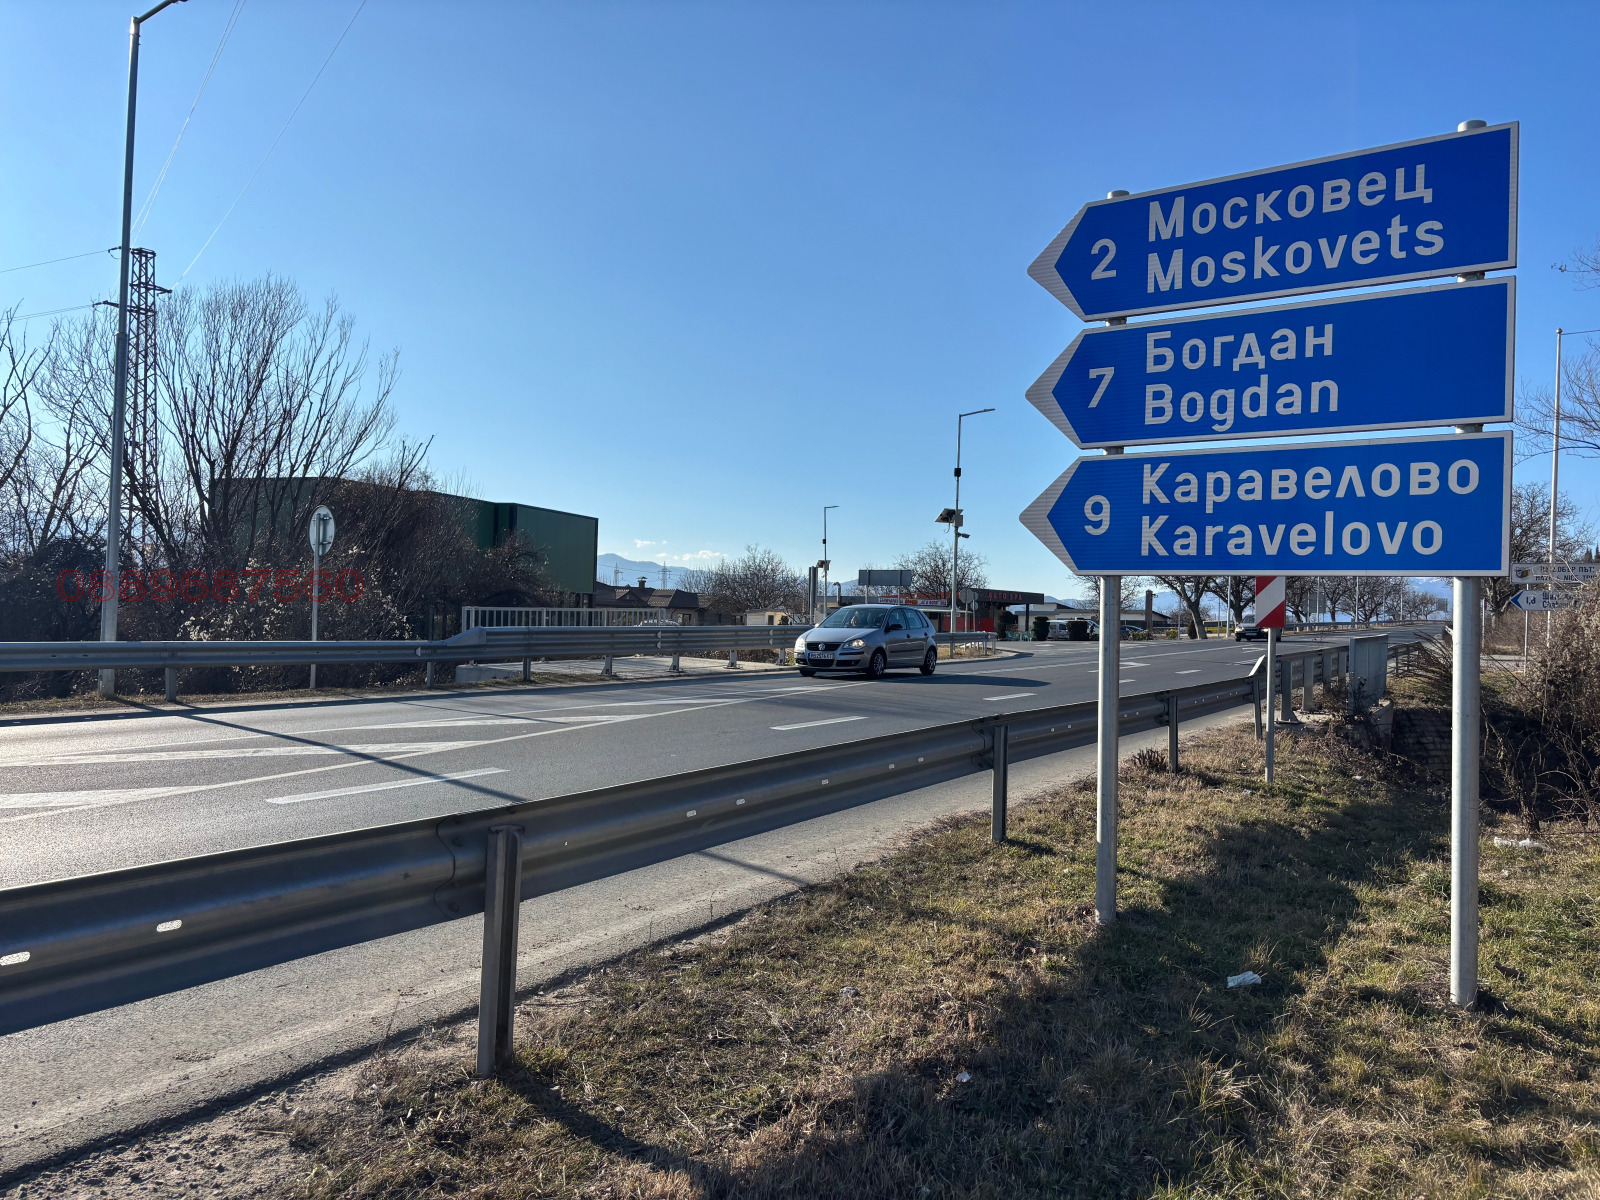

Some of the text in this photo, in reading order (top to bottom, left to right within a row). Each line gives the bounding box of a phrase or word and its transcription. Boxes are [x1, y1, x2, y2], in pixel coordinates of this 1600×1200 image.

[1148, 163, 1433, 242] Московец
[1091, 238, 1117, 280] 2
[1147, 216, 1444, 293] Moskovets
[1146, 323, 1334, 374] Богдан
[1088, 366, 1115, 408] 7
[1144, 374, 1339, 432] Bogdan
[1142, 459, 1480, 514] Каравелово
[1084, 495, 1111, 536] 9
[1141, 511, 1443, 556] Karavelovo
[988, 592, 1023, 601] AUTO SPA
